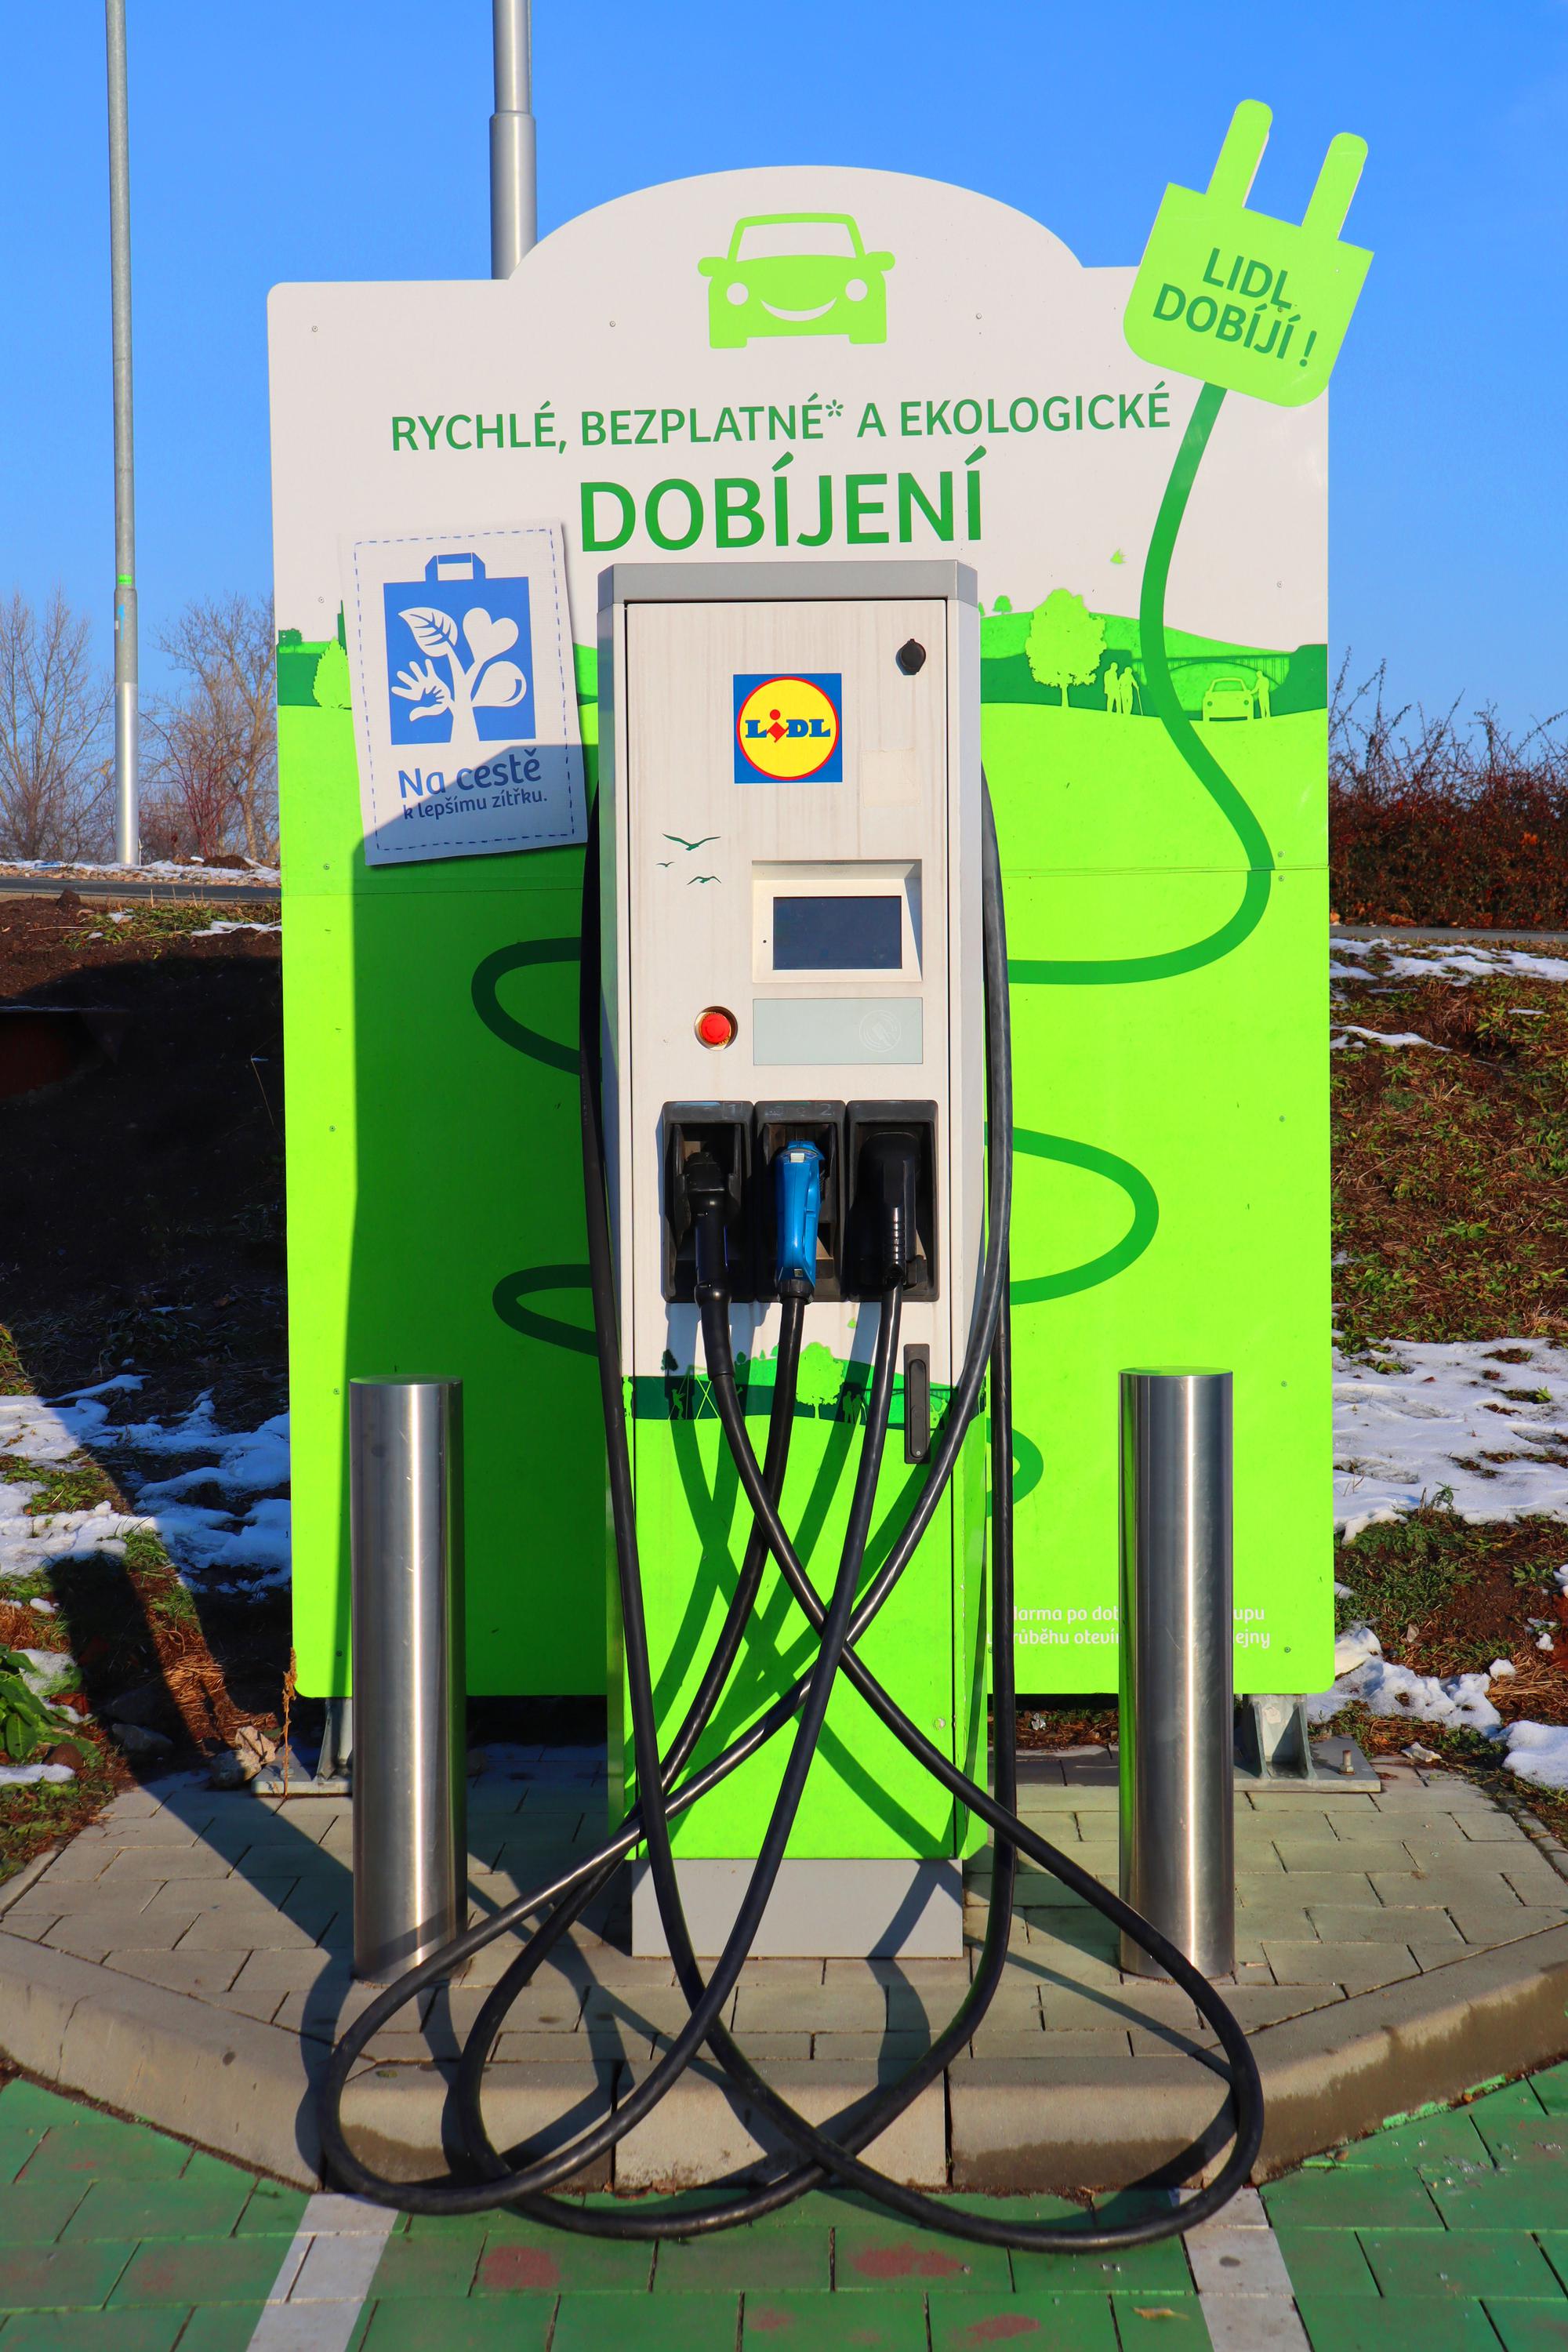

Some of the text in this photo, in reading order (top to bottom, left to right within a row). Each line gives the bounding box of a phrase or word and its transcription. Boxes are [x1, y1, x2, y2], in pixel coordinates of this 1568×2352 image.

[1202, 247, 1293, 311] LIDL
[392, 401, 567, 454] RYCHLÉ,
[857, 402, 887, 438] A
[900, 380, 1171, 437] EKOLOGICKÉ
[580, 446, 987, 553] DOBÍJENÍ
[398, 747, 542, 798] Na cestě
[403, 787, 548, 820] k lepšímu zítřku.
[1013, 1628, 1069, 1645] růběhu
[1074, 1627, 1120, 1644] oteví
[1235, 1628, 1271, 1649] ejny
[1014, 1605, 1062, 1621] arma
[1067, 1608, 1087, 1625] po
[1233, 1608, 1265, 1624] upu
